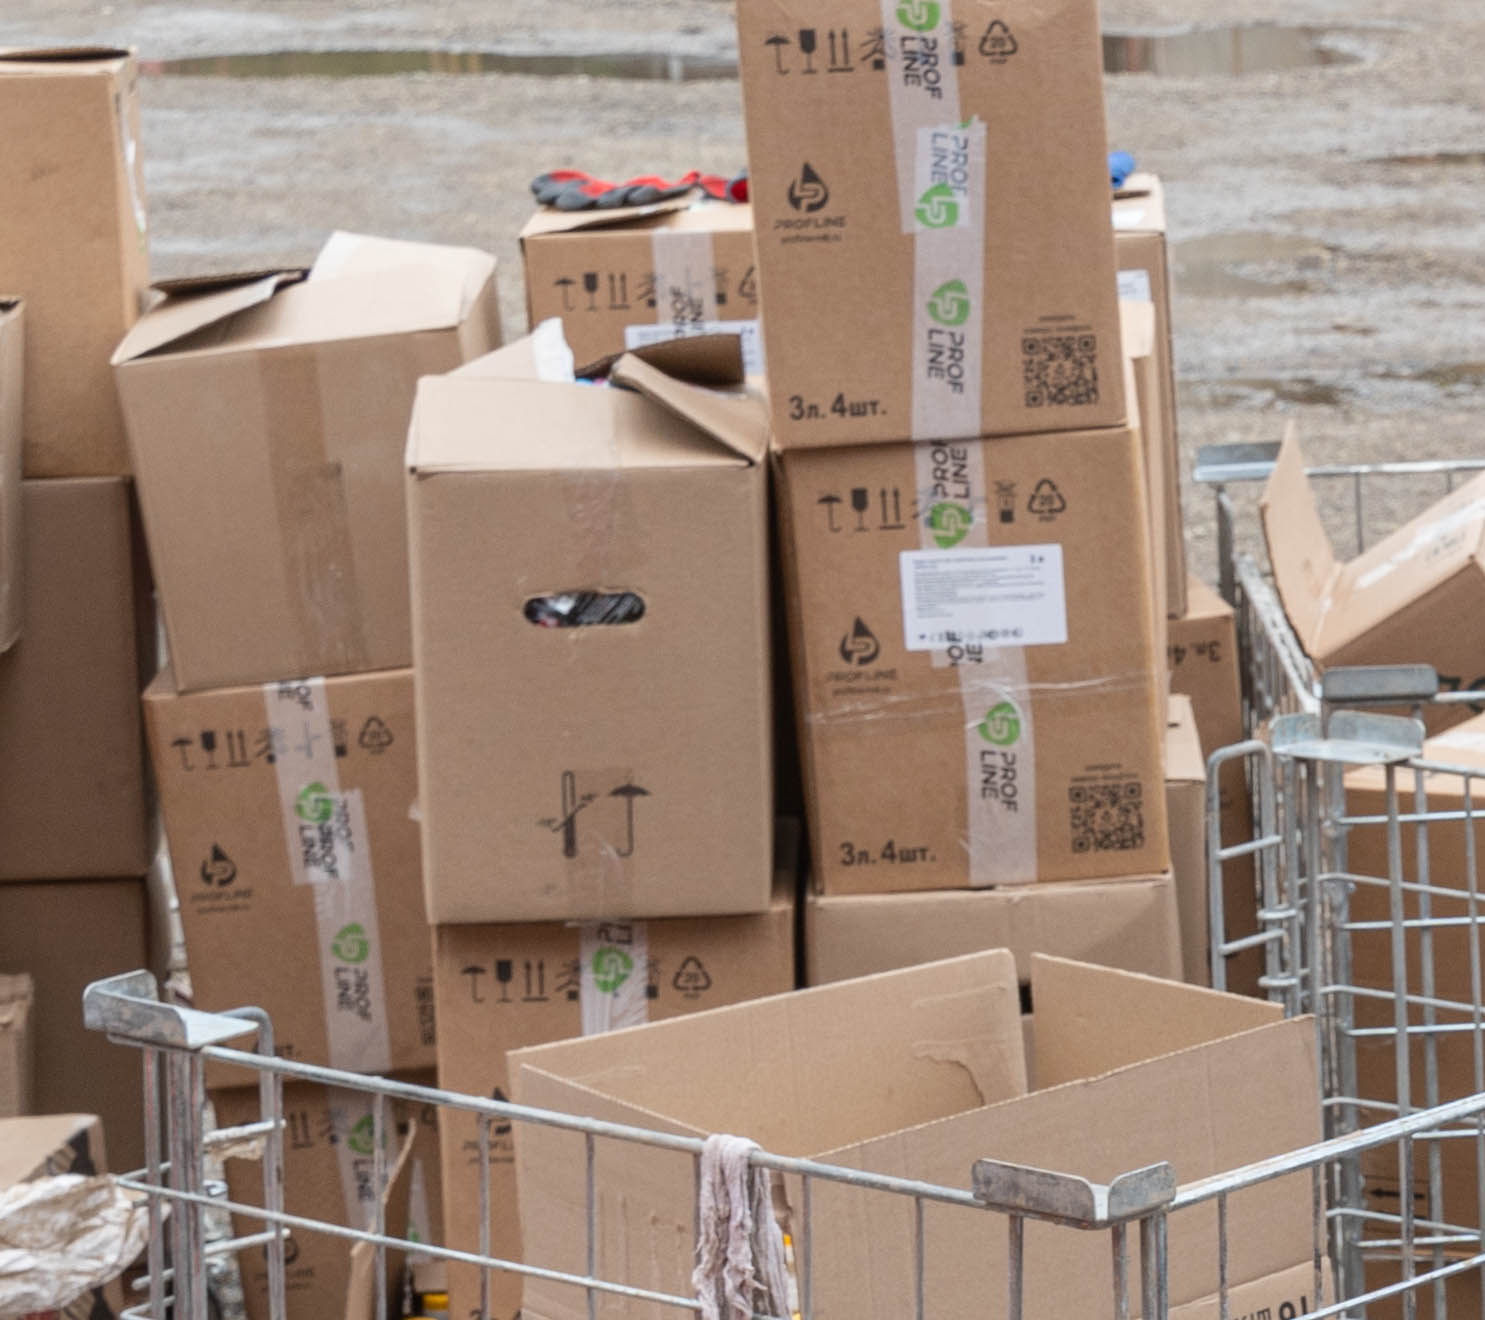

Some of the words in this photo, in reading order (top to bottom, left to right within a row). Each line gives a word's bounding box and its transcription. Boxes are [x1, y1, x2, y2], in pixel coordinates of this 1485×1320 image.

[926, 328, 947, 379] LINE
[946, 330, 967, 394] PROF
[979, 750, 998, 801] LINE
[998, 751, 1019, 813] PROF
